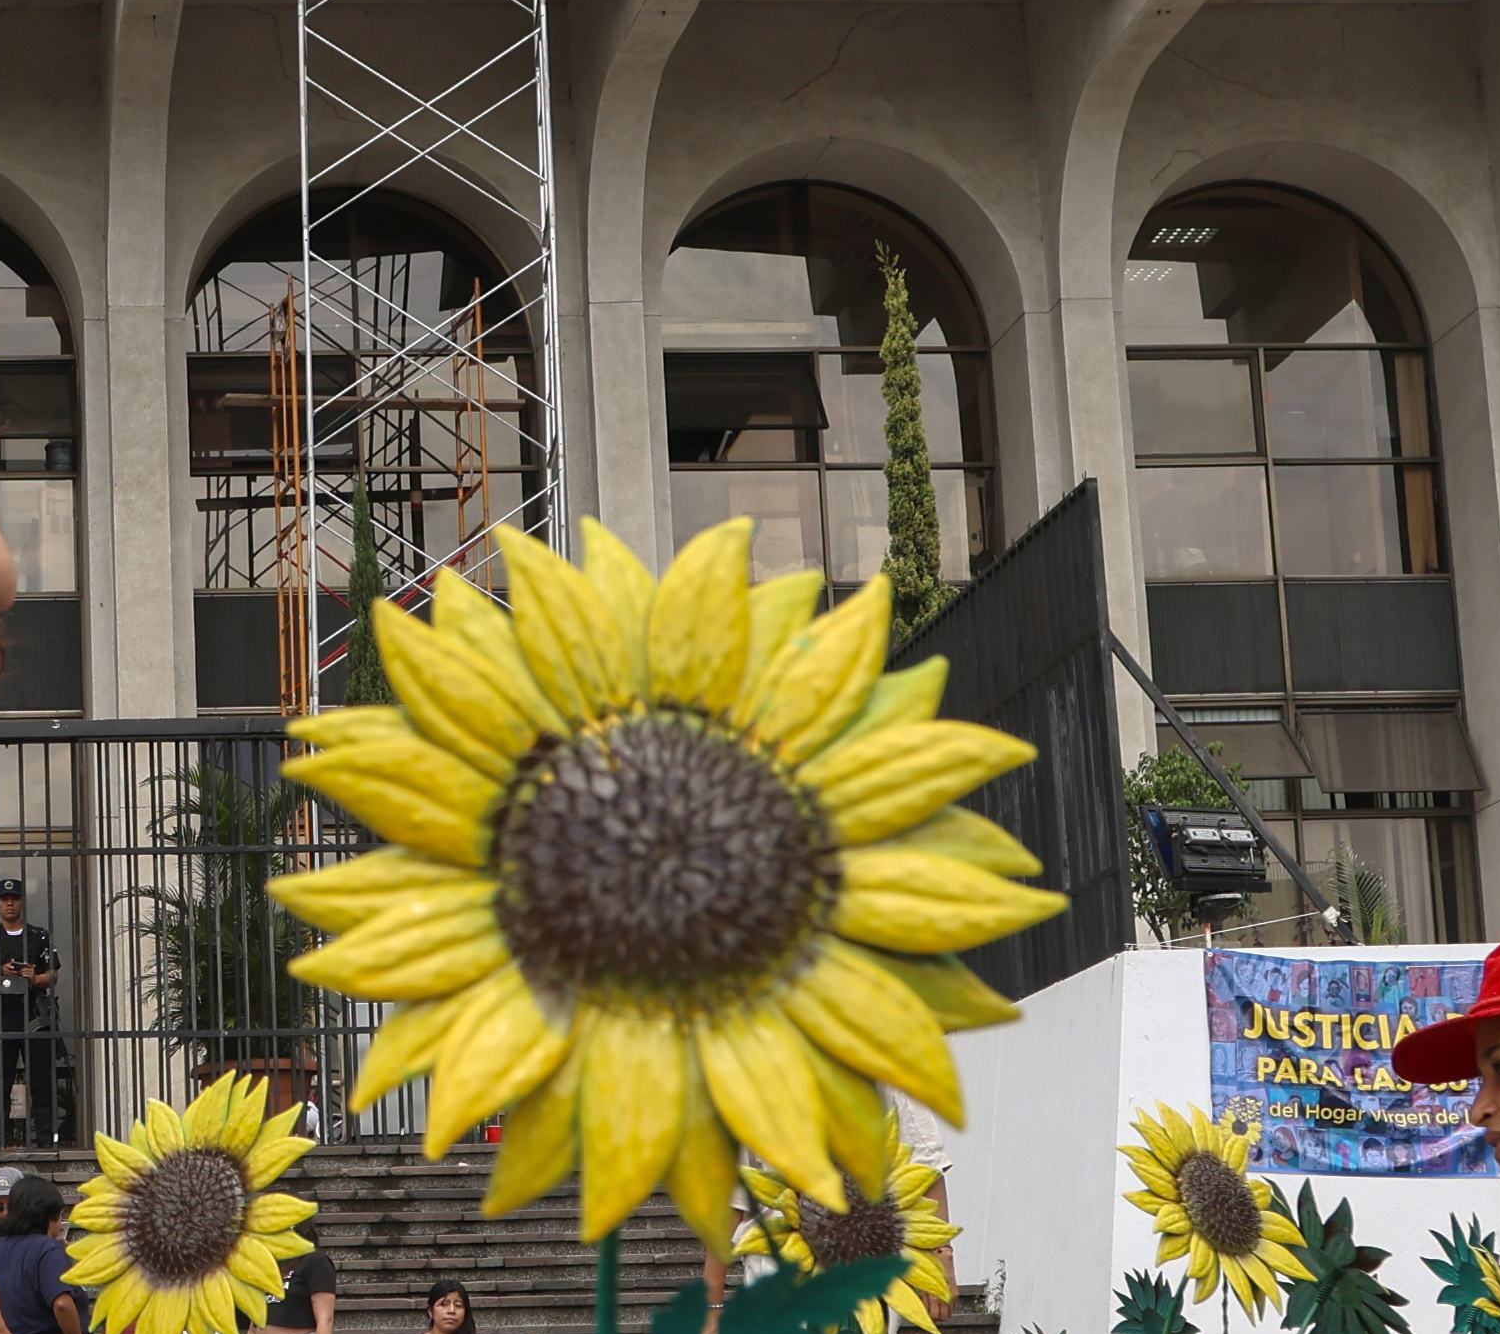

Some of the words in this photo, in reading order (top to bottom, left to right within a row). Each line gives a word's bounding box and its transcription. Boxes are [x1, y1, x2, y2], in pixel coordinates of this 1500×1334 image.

[1243, 1002, 1417, 1050] JUSTICIA
[1257, 1056, 1343, 1087] PARA
[1269, 1102, 1298, 1119] del
[1305, 1104, 1365, 1125] Hogar
[1369, 1108, 1431, 1128] Virgen
[1435, 1110, 1460, 1125] de
